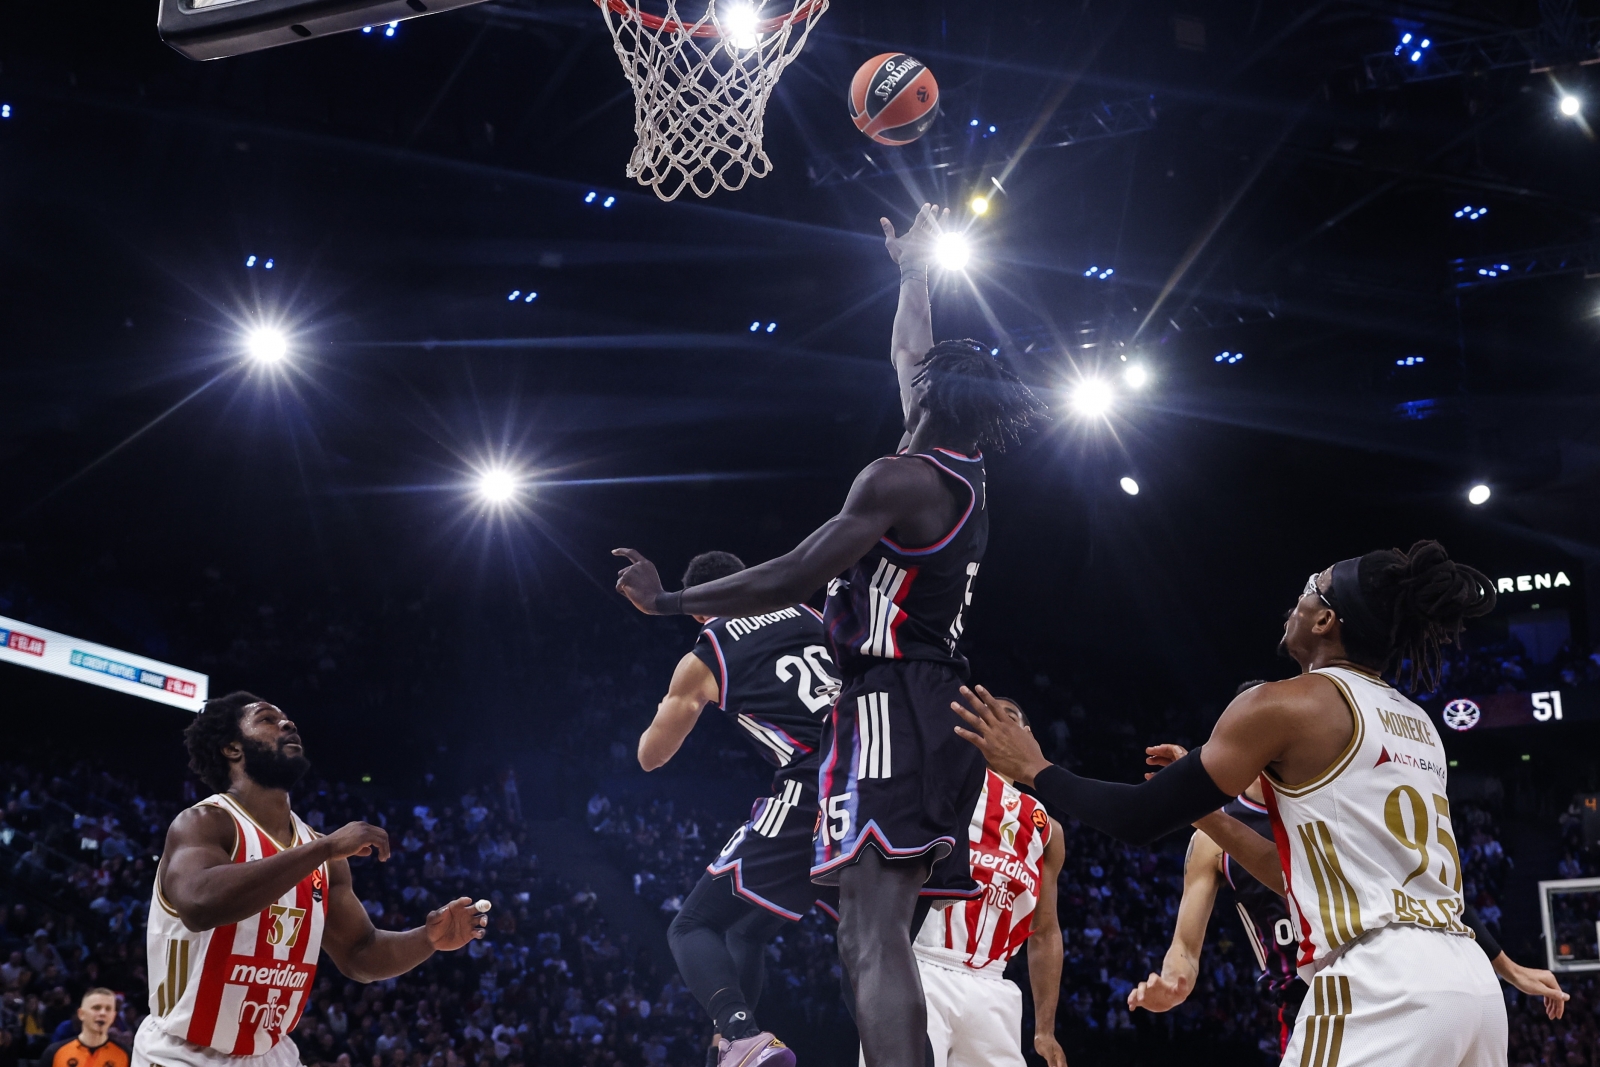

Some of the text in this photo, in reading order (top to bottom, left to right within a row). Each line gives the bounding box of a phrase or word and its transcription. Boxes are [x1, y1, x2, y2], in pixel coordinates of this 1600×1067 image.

[1478, 572, 1571, 596] RENA
[1531, 690, 1563, 722] 51
[1376, 707, 1436, 747] MONEKE
[820, 792, 852, 847] 15
[1384, 785, 1462, 894] 95
[266, 903, 307, 949] 37
[229, 962, 309, 988] meridian
[238, 996, 288, 1031] mts
